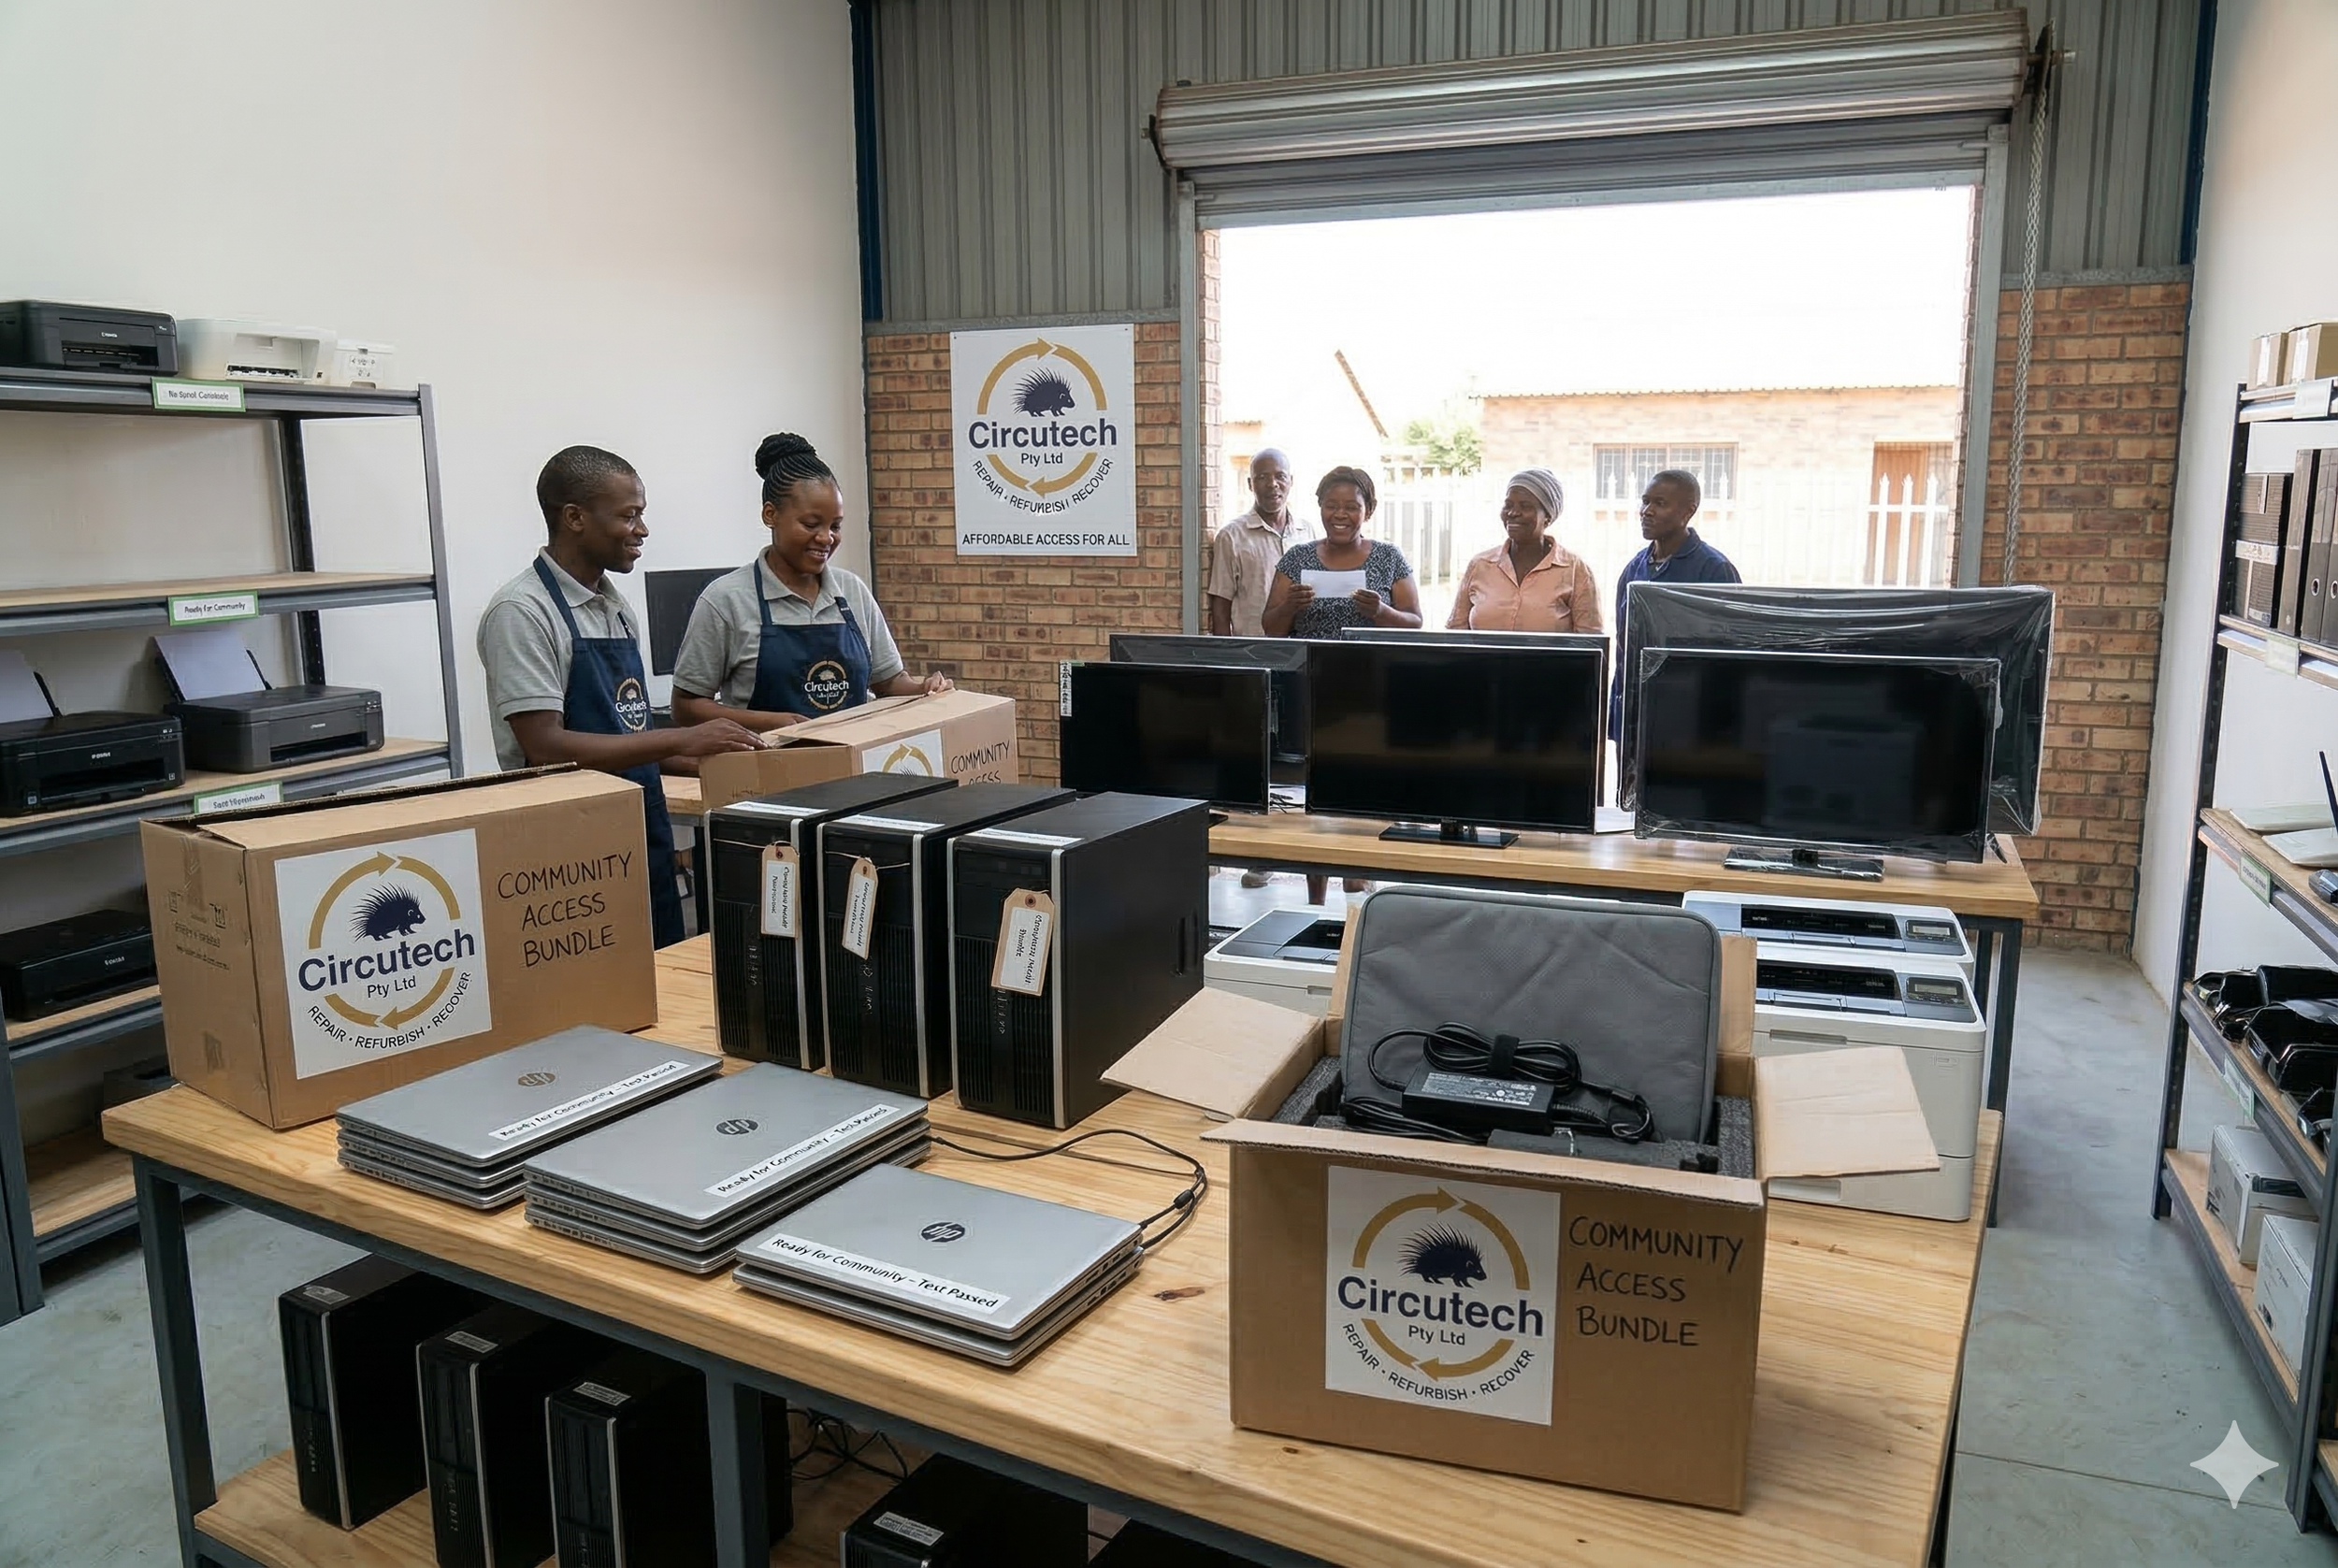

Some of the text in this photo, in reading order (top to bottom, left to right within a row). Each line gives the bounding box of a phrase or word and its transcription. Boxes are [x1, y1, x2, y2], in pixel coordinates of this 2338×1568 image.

[968, 418, 1117, 449] Circutech
[973, 460, 1003, 499] REPAIR
[1072, 457, 1115, 505] RECOVER
[1020, 453, 1063, 468] Pty Ltd
[962, 532, 1131, 546] AFFORDABLE ACCESS FOR ALL
[950, 740, 1010, 774] COMMUNITY
[498, 851, 632, 899] COMMUNITY
[522, 892, 606, 931] ACCESS
[297, 928, 475, 992] Circutech
[523, 925, 616, 968] BUNDLE
[367, 975, 417, 999] Pty Ltd
[307, 1005, 347, 1043] REPAIR
[354, 1026, 426, 1049] REFURBISH
[1568, 1216, 1744, 1273] COMMUNITY
[832, 1256, 908, 1283] Community
[1577, 1261, 1686, 1302] ACCESS
[1337, 1275, 1543, 1337] Circutech
[1576, 1304, 1699, 1346] BUNDLE
[1408, 1324, 1465, 1345] Pty Ltd
[1342, 1323, 1536, 1401] REPAIR REFURBISH RECOVER
